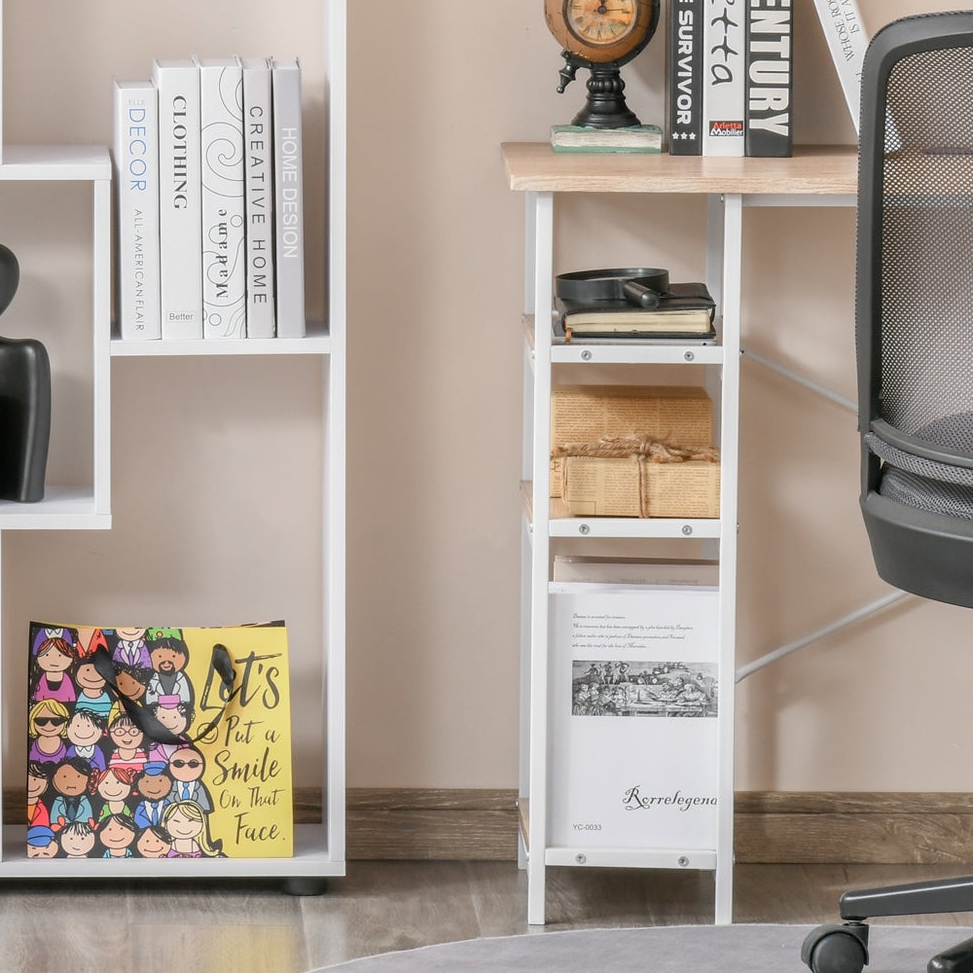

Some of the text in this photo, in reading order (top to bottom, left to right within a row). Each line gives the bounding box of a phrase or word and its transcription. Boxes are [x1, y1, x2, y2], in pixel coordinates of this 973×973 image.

[843, 10, 856, 21] IT
[850, 23, 860, 34] IS
[835, 20, 855, 62] WHOSE
[677, 10, 694, 125] SURVIVOR
[128, 108, 147, 192] DECOR
[173, 95, 188, 210] CLOTHING
[249, 106, 267, 304] CREATIVE HOME
[282, 127, 298, 258] HOME DESIGN
[216, 209, 228, 298] Madame
[169, 312, 194, 320] Better
[225, 715, 280, 747] Put a
[212, 747, 281, 785] Smile
[219, 787, 285, 809] On That
